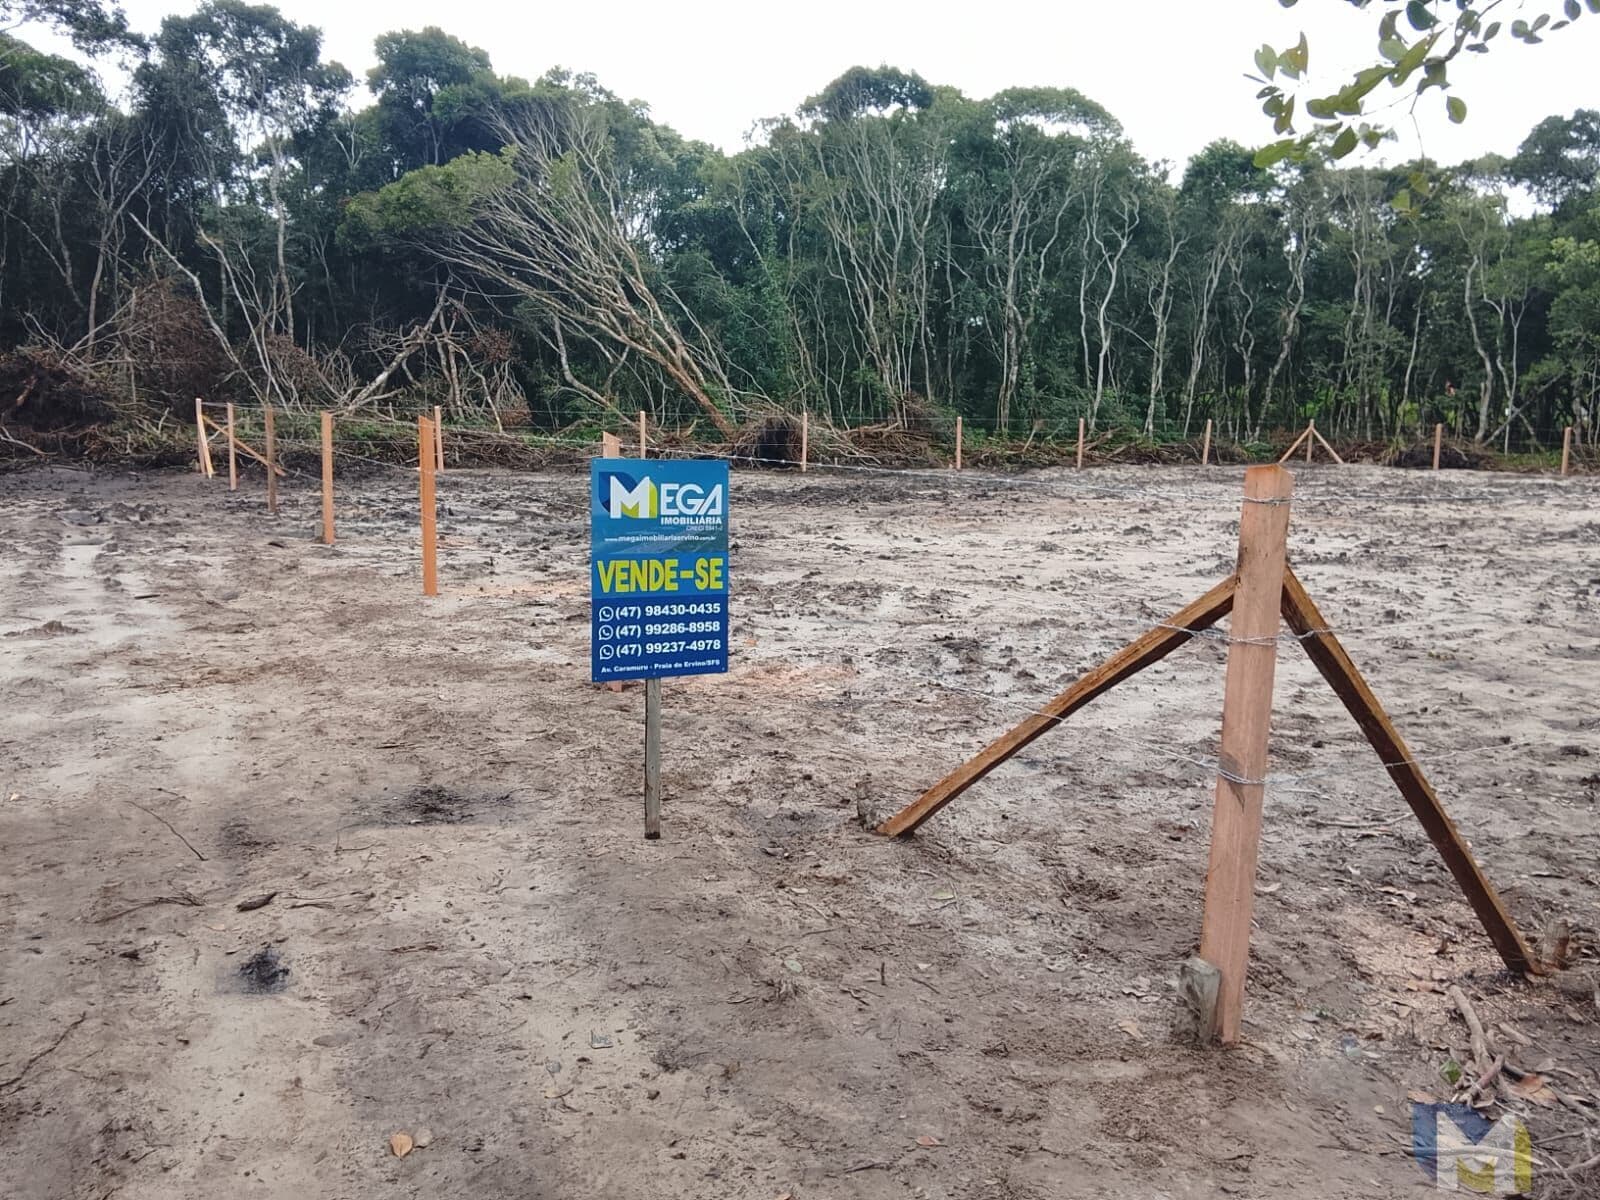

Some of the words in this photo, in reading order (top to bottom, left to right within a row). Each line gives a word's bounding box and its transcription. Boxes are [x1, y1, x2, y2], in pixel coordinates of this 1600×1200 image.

[610, 475, 723, 519] MEGA
[660, 515, 723, 525] IMOBILIÁRIA
[597, 557, 723, 593] VENDE-SE
[615, 606, 641, 620] (47)
[645, 603, 721, 617] 98430-0435
[615, 624, 641, 639] (47)
[645, 621, 720, 635] 99286-8958
[616, 643, 642, 658] (47)
[645, 639, 721, 654] 99237-4978
[654, 662, 672, 670] Praia
